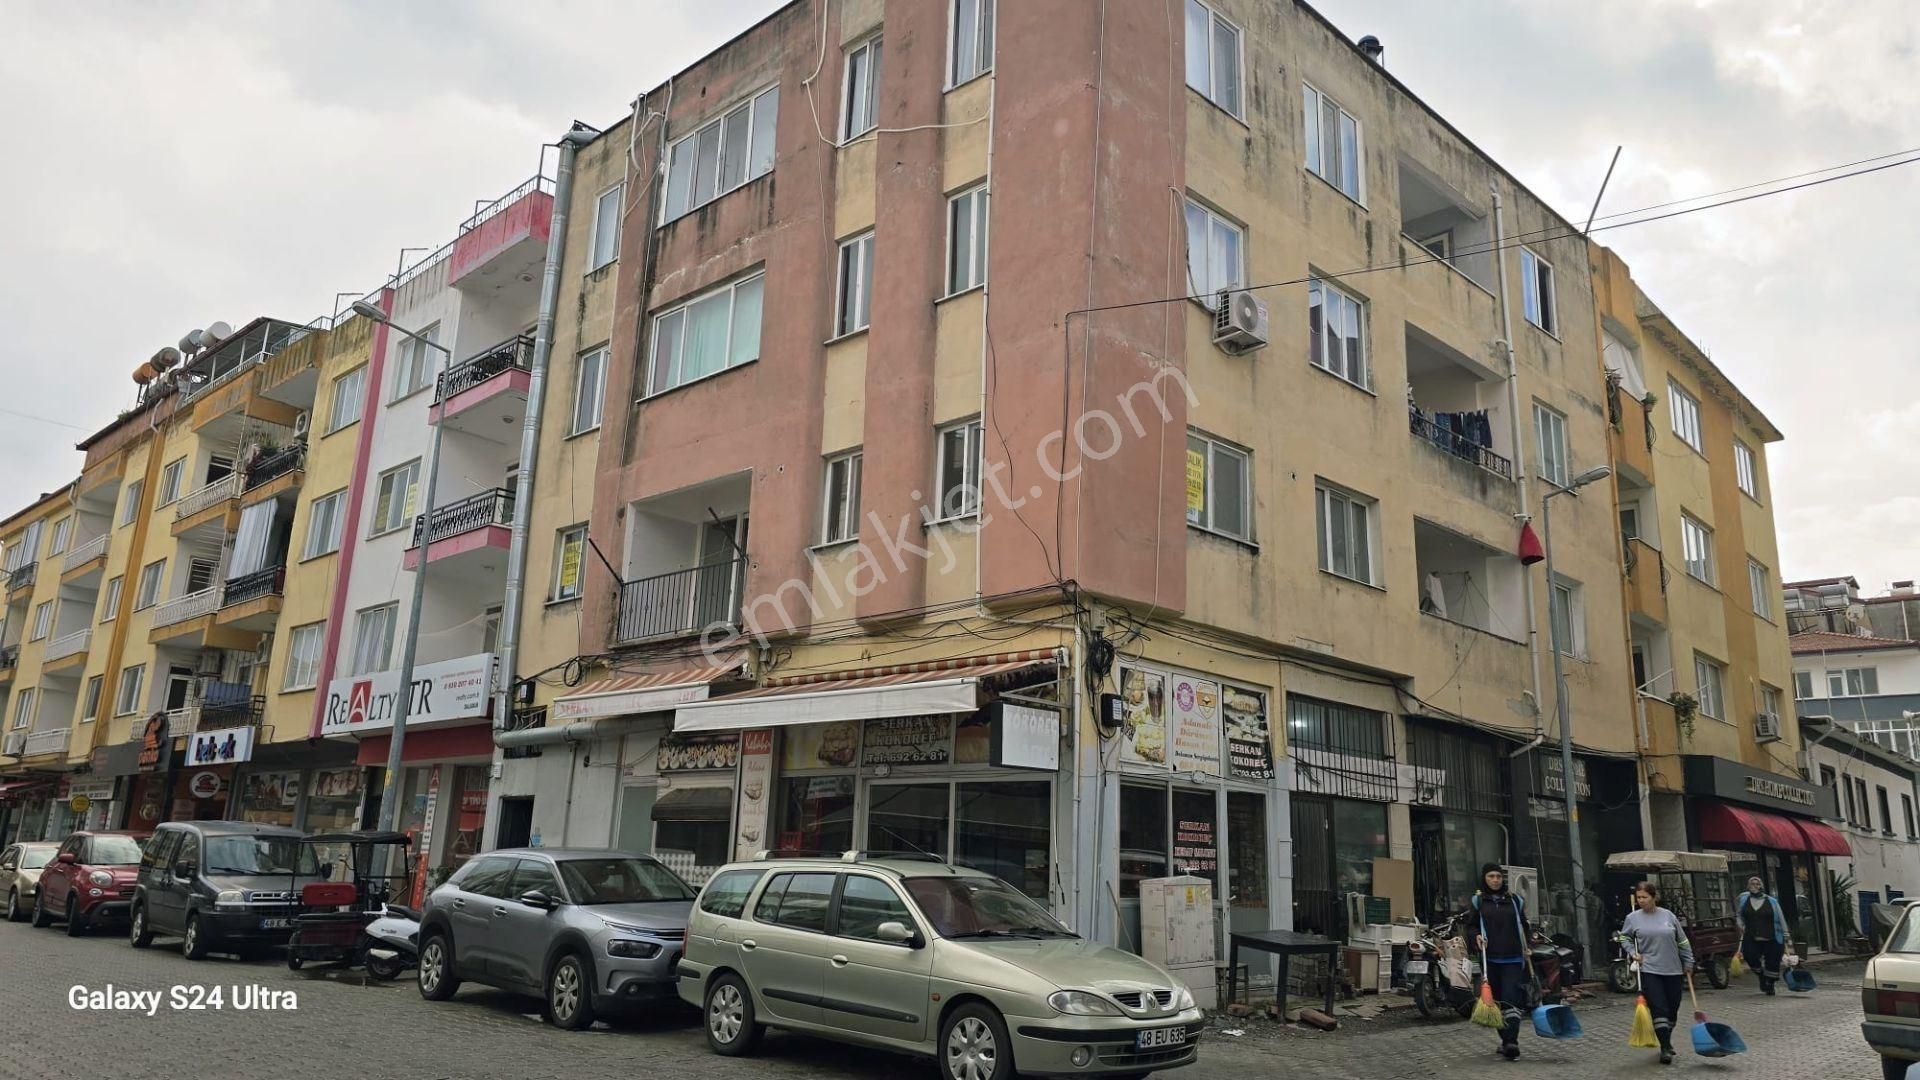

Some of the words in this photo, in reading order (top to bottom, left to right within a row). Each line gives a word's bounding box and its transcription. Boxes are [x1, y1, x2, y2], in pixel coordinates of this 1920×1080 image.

[880, 716, 932, 730] SERKAN
[1230, 743, 1262, 756] SERKAN
[890, 752, 910, 762] 692
[913, 752, 927, 762] 62
[930, 751, 944, 761] 81
[1263, 770, 1275, 779] 81
[1545, 775, 1592, 797] COLLTION
[1140, 1031, 1152, 1046] 48
[1155, 1029, 1168, 1045] EU
[1169, 1027, 1185, 1043] 635
